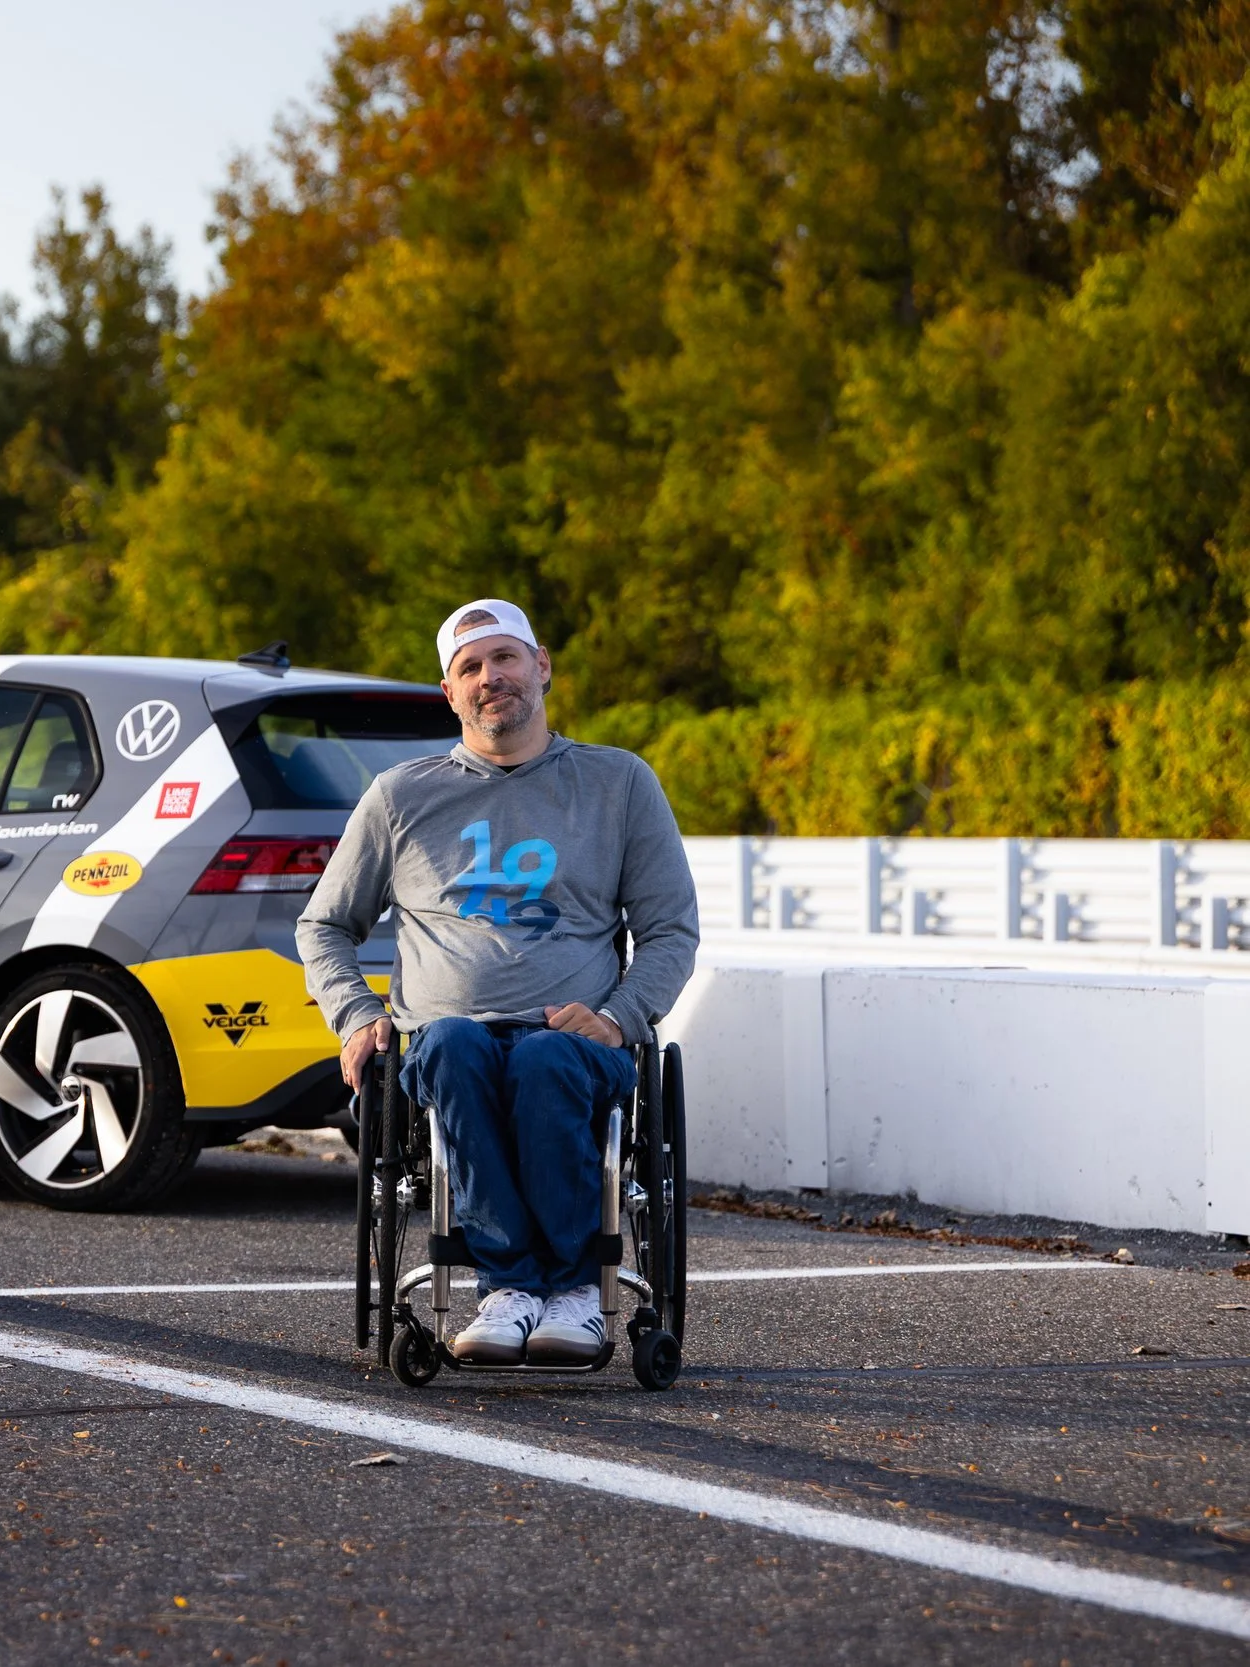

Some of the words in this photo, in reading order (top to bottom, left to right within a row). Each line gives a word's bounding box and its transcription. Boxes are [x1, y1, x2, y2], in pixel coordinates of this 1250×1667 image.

[165, 787, 193, 796] LIME
[160, 804, 189, 814] PARK
[72, 863, 129, 883] PENNZOIL
[202, 1015, 270, 1029] VEIGEL
